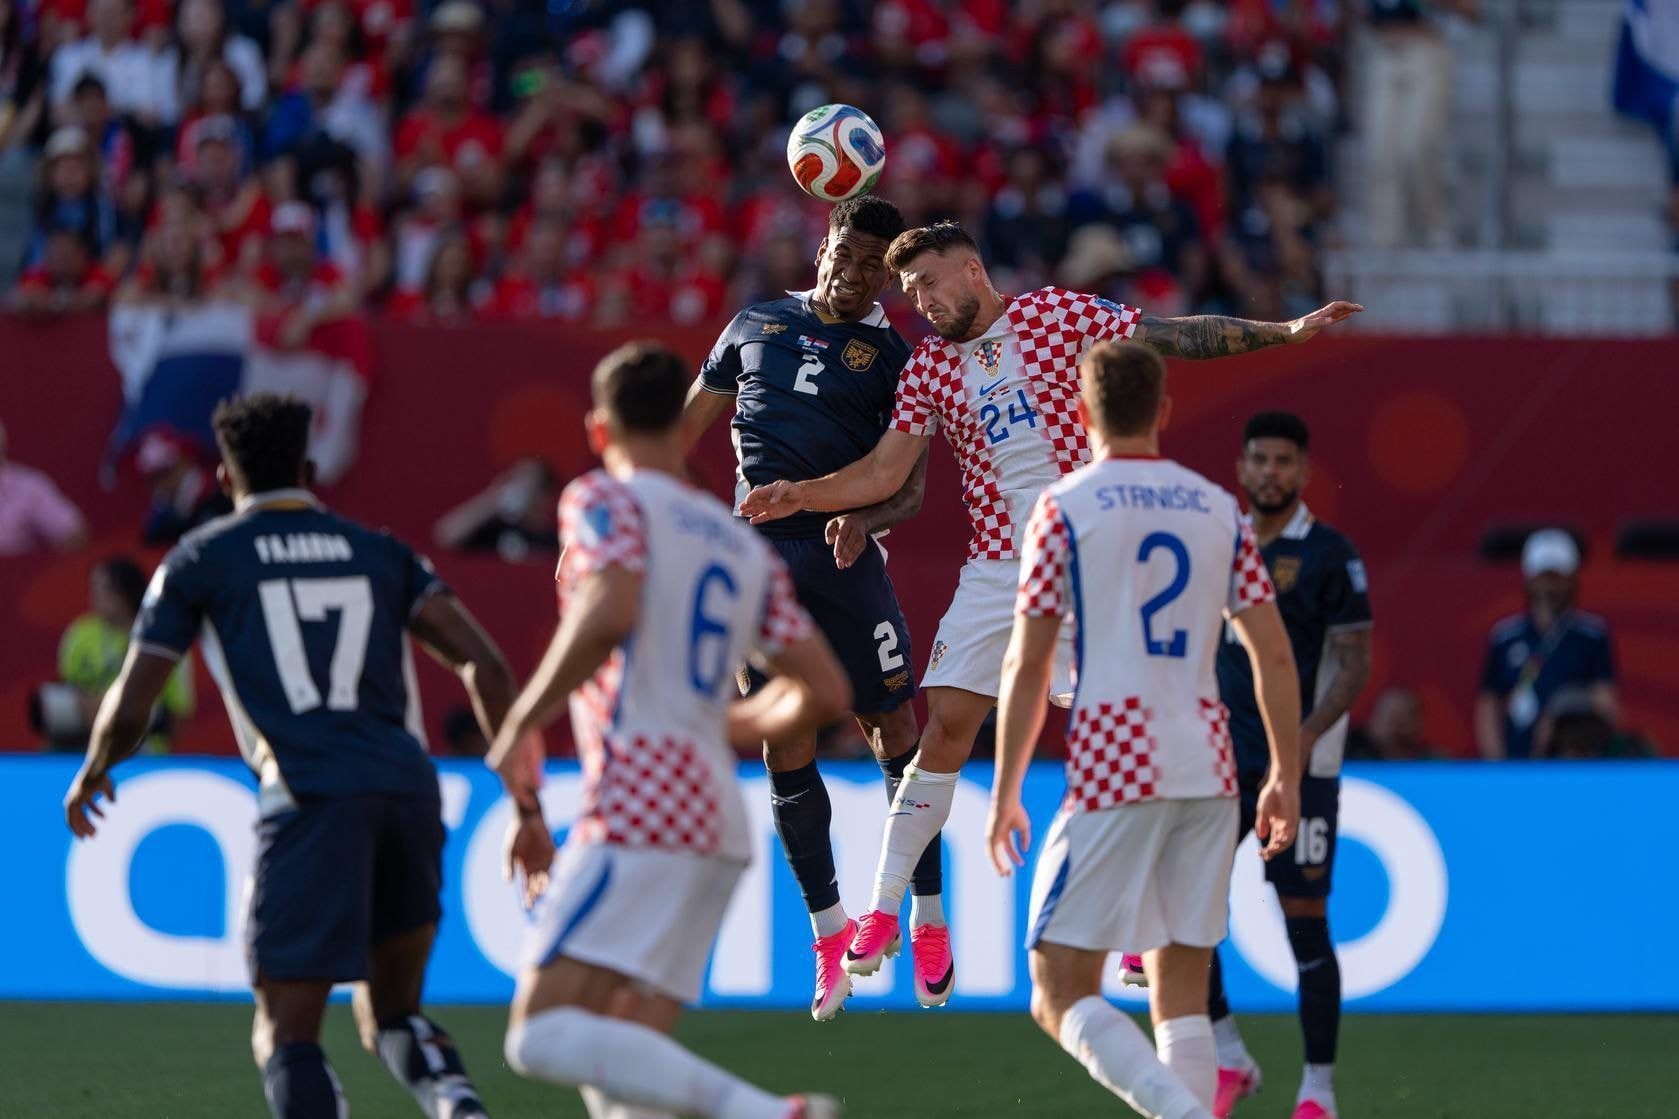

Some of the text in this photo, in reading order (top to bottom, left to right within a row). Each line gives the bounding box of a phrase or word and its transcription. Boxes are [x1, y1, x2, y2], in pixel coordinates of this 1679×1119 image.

[793, 354, 825, 395] 2
[980, 389, 1037, 445] 24
[687, 562, 739, 700] 6
[1136, 531, 1190, 659] 2
[258, 575, 375, 715] 17
[873, 620, 904, 672] 2
[68, 771, 1449, 998] amo
[1294, 816, 1329, 866] 16
